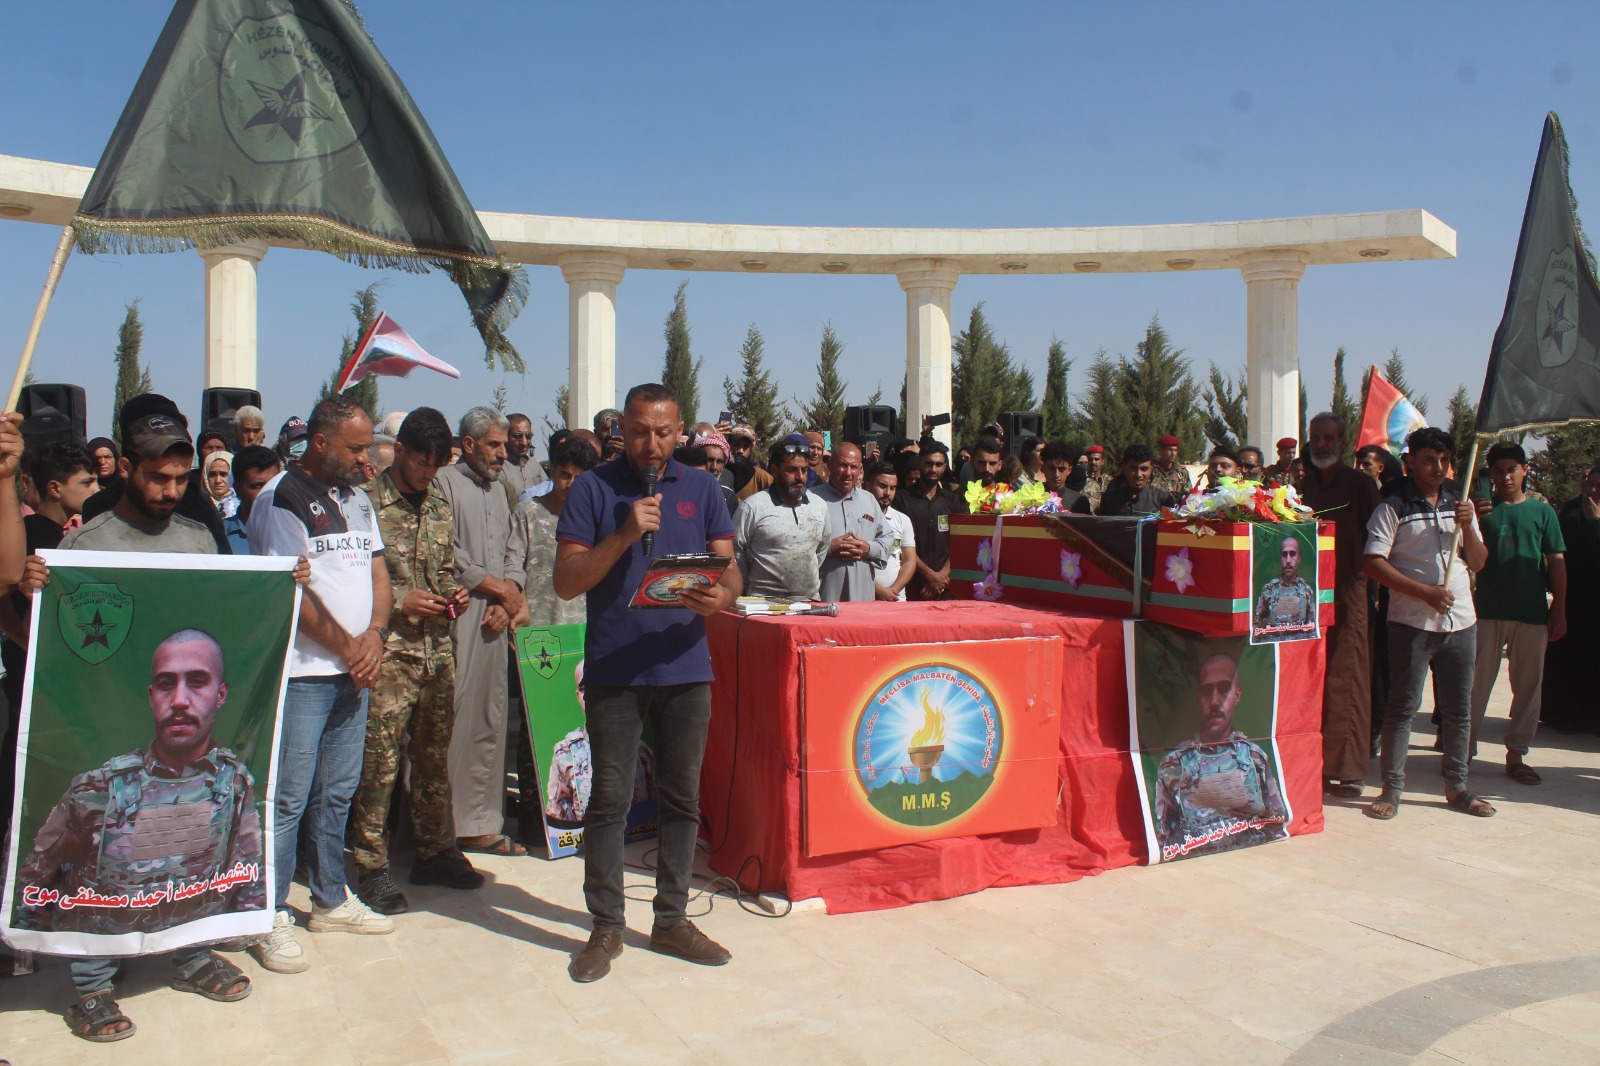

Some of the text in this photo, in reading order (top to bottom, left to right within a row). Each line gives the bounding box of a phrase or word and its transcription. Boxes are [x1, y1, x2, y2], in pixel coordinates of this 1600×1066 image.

[315, 537, 354, 552] BLACK
[902, 791, 951, 810] M.M.Ş
[1228, 820, 1249, 835] محمد
[1163, 843, 1180, 860] موح
[1181, 833, 1209, 855] مصطفى
[23, 861, 259, 910] الشهيد محمد أحمد مصطفى موح
